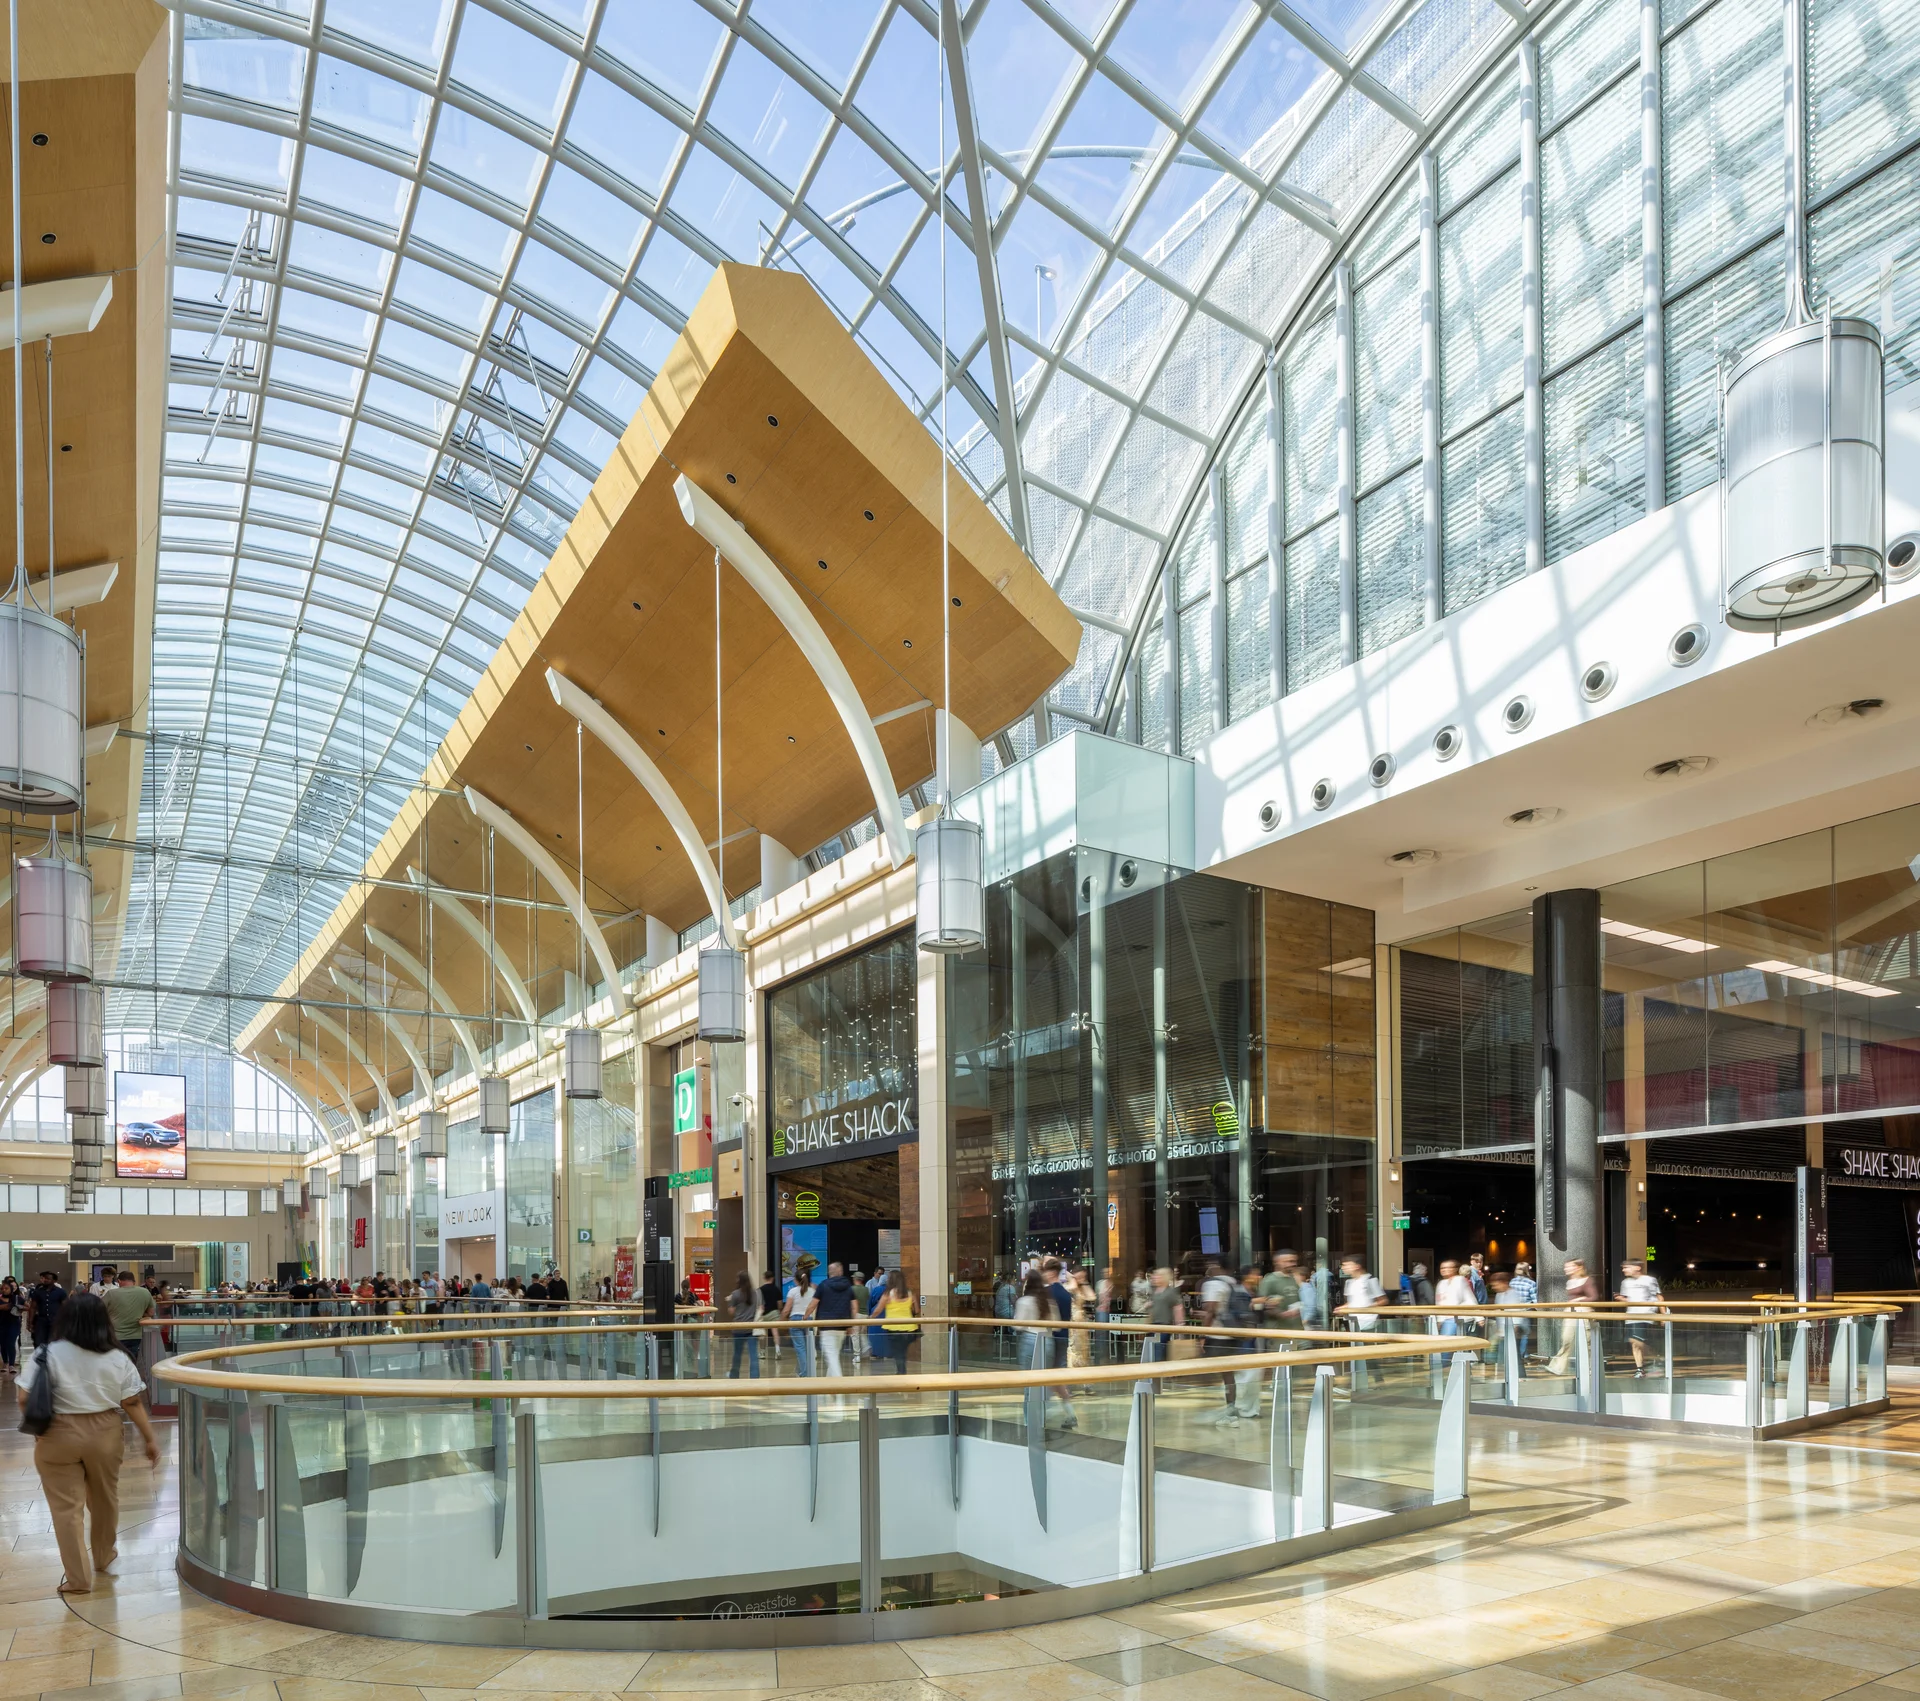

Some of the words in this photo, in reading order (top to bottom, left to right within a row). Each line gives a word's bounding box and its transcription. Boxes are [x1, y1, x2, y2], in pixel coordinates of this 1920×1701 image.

[677, 1082, 693, 1121] D
[786, 1114, 839, 1155] SHAKE
[844, 1098, 912, 1143] SHACK
[1655, 1164, 1671, 1174] HOT
[1671, 1164, 1691, 1176] DOGS
[1844, 1149, 1890, 1178] SHAKE
[445, 1211, 464, 1226] NEW
[467, 1206, 492, 1223] LOOK
[580, 1230, 590, 1241] D
[746, 1593, 796, 1612] eastside
